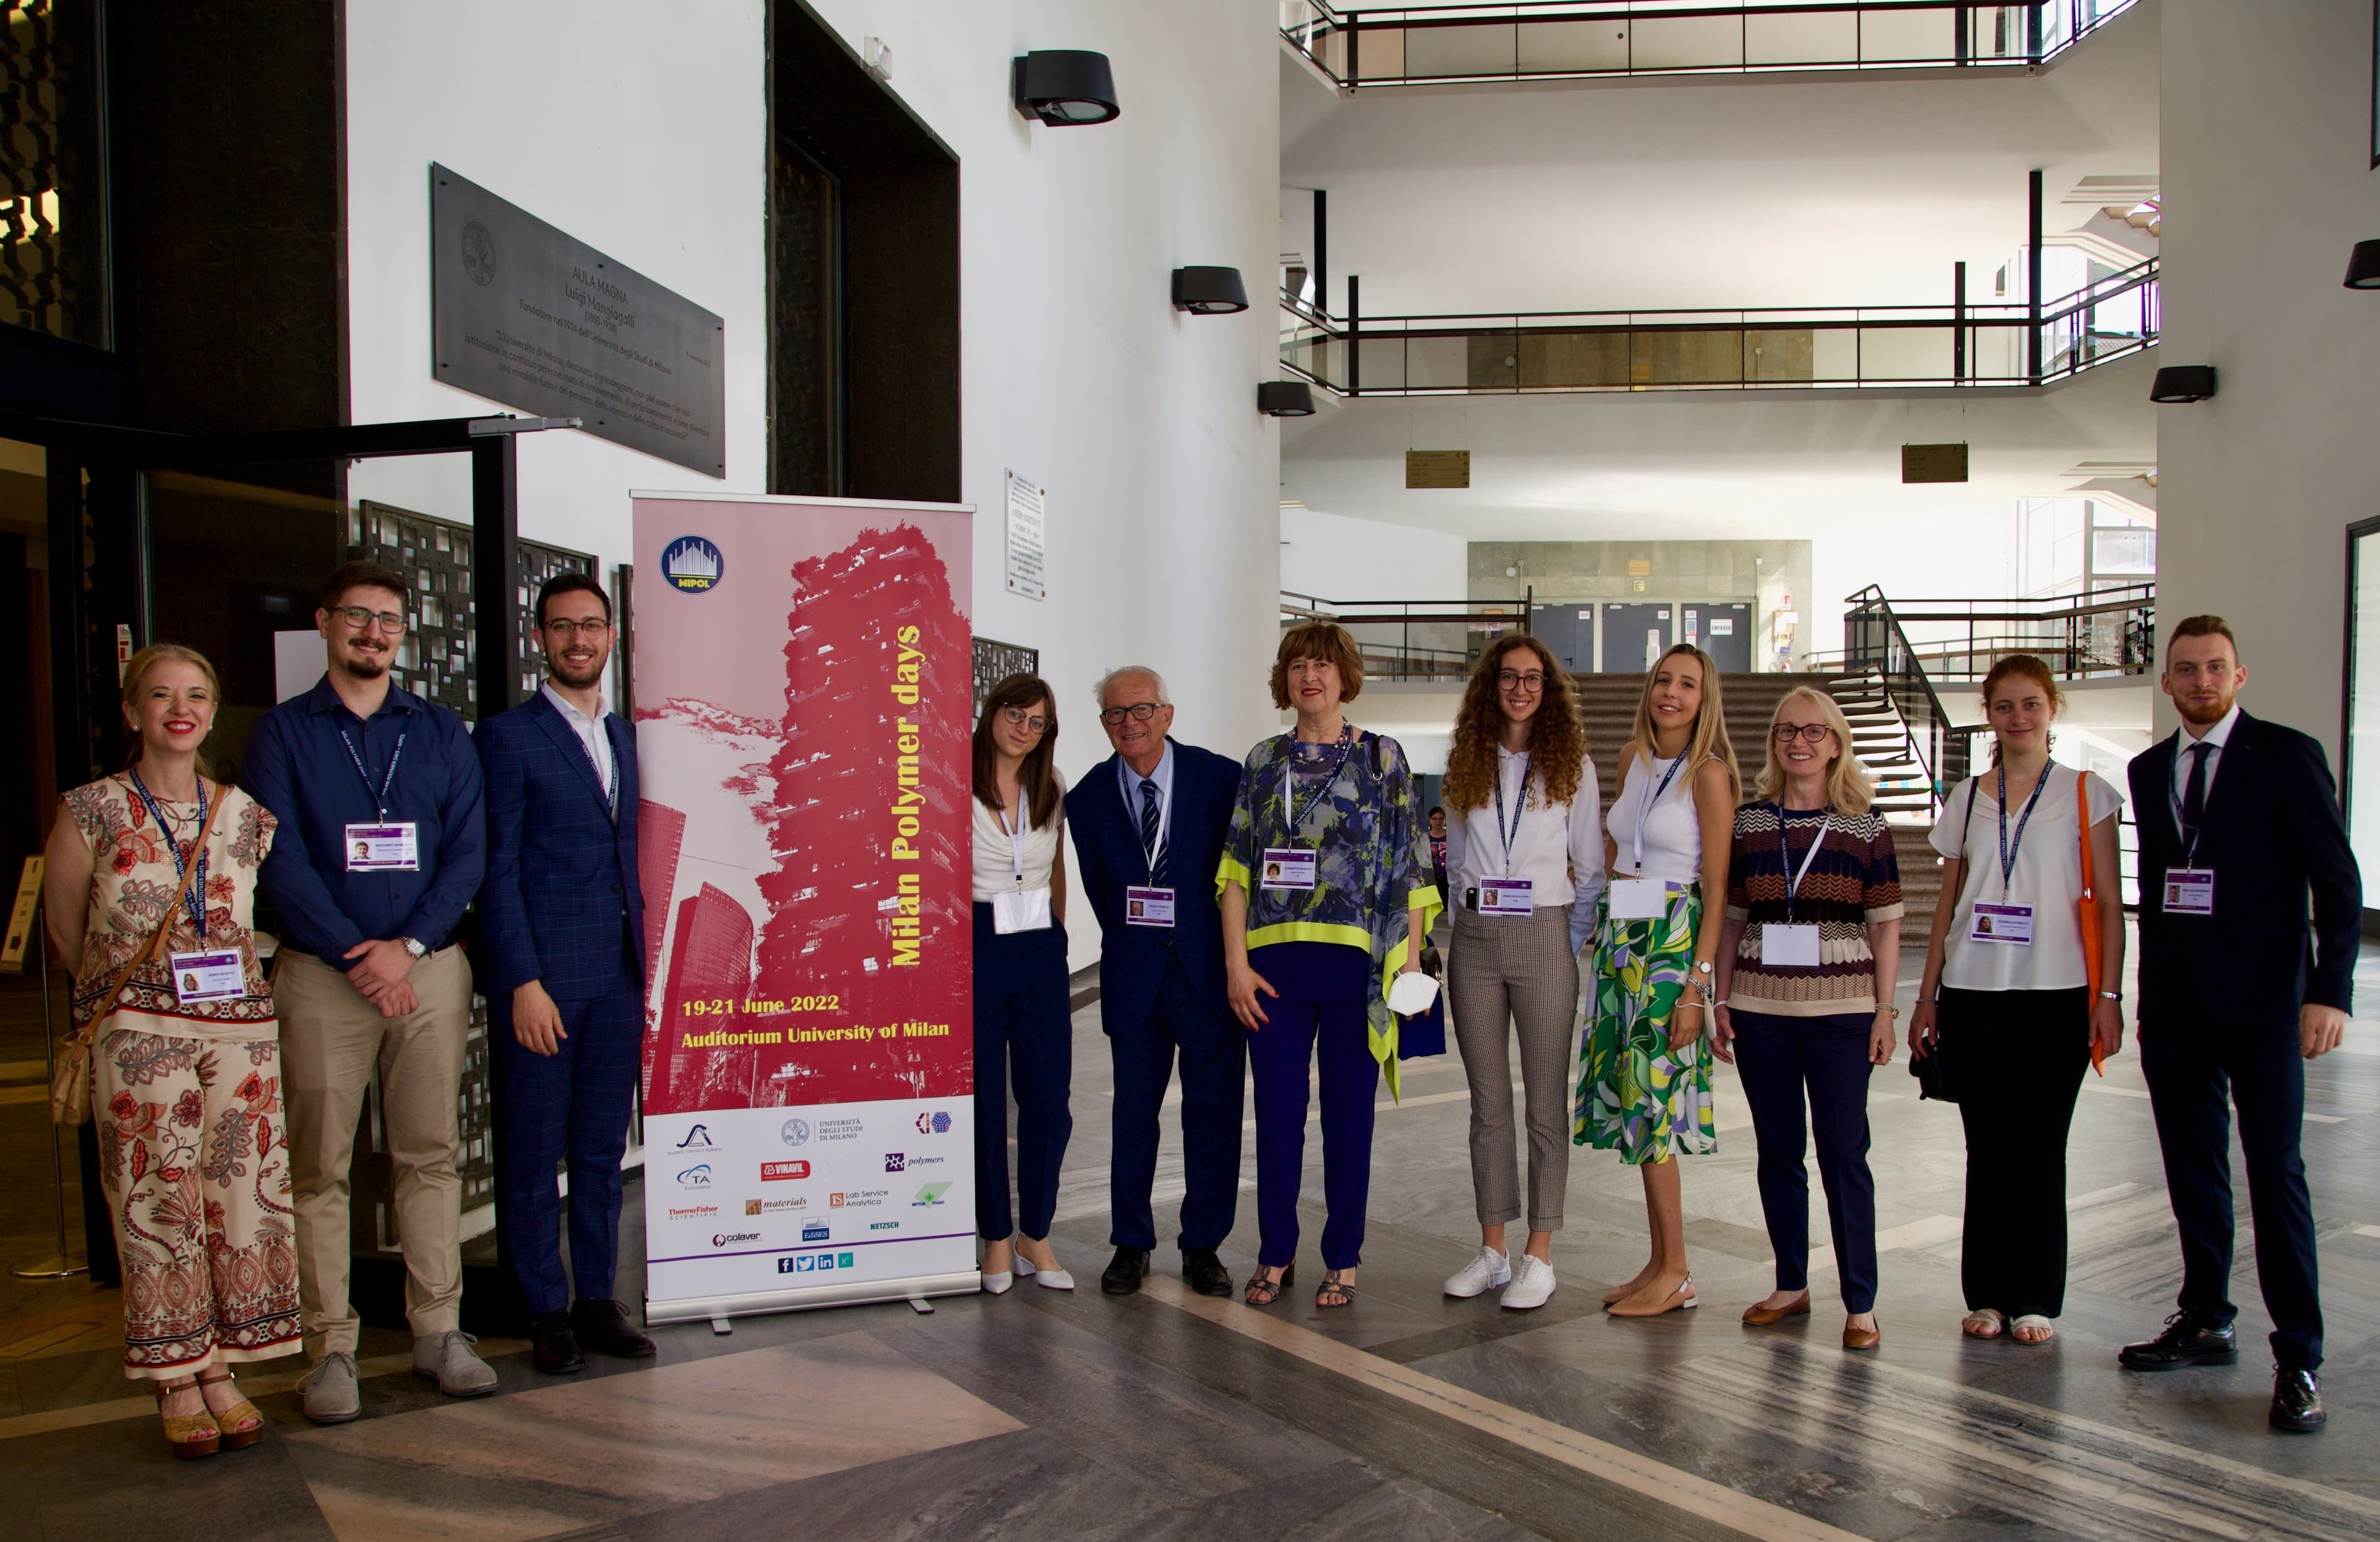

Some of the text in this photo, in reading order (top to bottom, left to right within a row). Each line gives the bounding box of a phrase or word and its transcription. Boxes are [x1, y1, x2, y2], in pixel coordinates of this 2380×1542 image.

[571, 265, 628, 306] AULA MAGNA
[565, 281, 635, 333] Luigi Mangiagalli
[584, 309, 617, 337] (1850-1928)
[519, 298, 552, 323] Fondatore
[553, 313, 563, 328] nel
[563, 317, 577, 334] 1924
[619, 343, 633, 361] degli
[634, 350, 647, 365] Studi
[648, 356, 654, 368] di
[654, 359, 671, 376] Milano
[464, 332, 500, 356] istituzione
[500, 346, 508, 358] in
[536, 345, 542, 358] di
[544, 348, 565, 368] Milano,
[679, 579, 710, 588] MIPOL
[891, 625, 927, 966] Milan Polymer days
[1295, 813, 1305, 826] MILAN
[1305, 798, 1319, 814] POLYMER
[1318, 790, 1326, 800] DAYS
[1326, 777, 1336, 788] MIPOL
[151, 803, 162, 821] MIPOL
[172, 844, 181, 861] MILAN
[683, 995, 839, 1016] 19-21 June 2022
[682, 1023, 949, 1048] Auditorium University of Milan
[819, 1119, 860, 1127] UNIVERSITÀ
[908, 1156, 944, 1166] polymers
[775, 1163, 804, 1174] VINAVIL
[692, 1176, 710, 1184] TA
[862, 1189, 889, 1197] Service
[764, 1197, 807, 1208] materials
[845, 1199, 882, 1208] Analytica
[669, 1212, 717, 1220] SCIENTIFIC
[870, 1222, 899, 1230] NETZSCH
[726, 1233, 761, 1242] colaver
[804, 1230, 828, 1239] EdiSES
